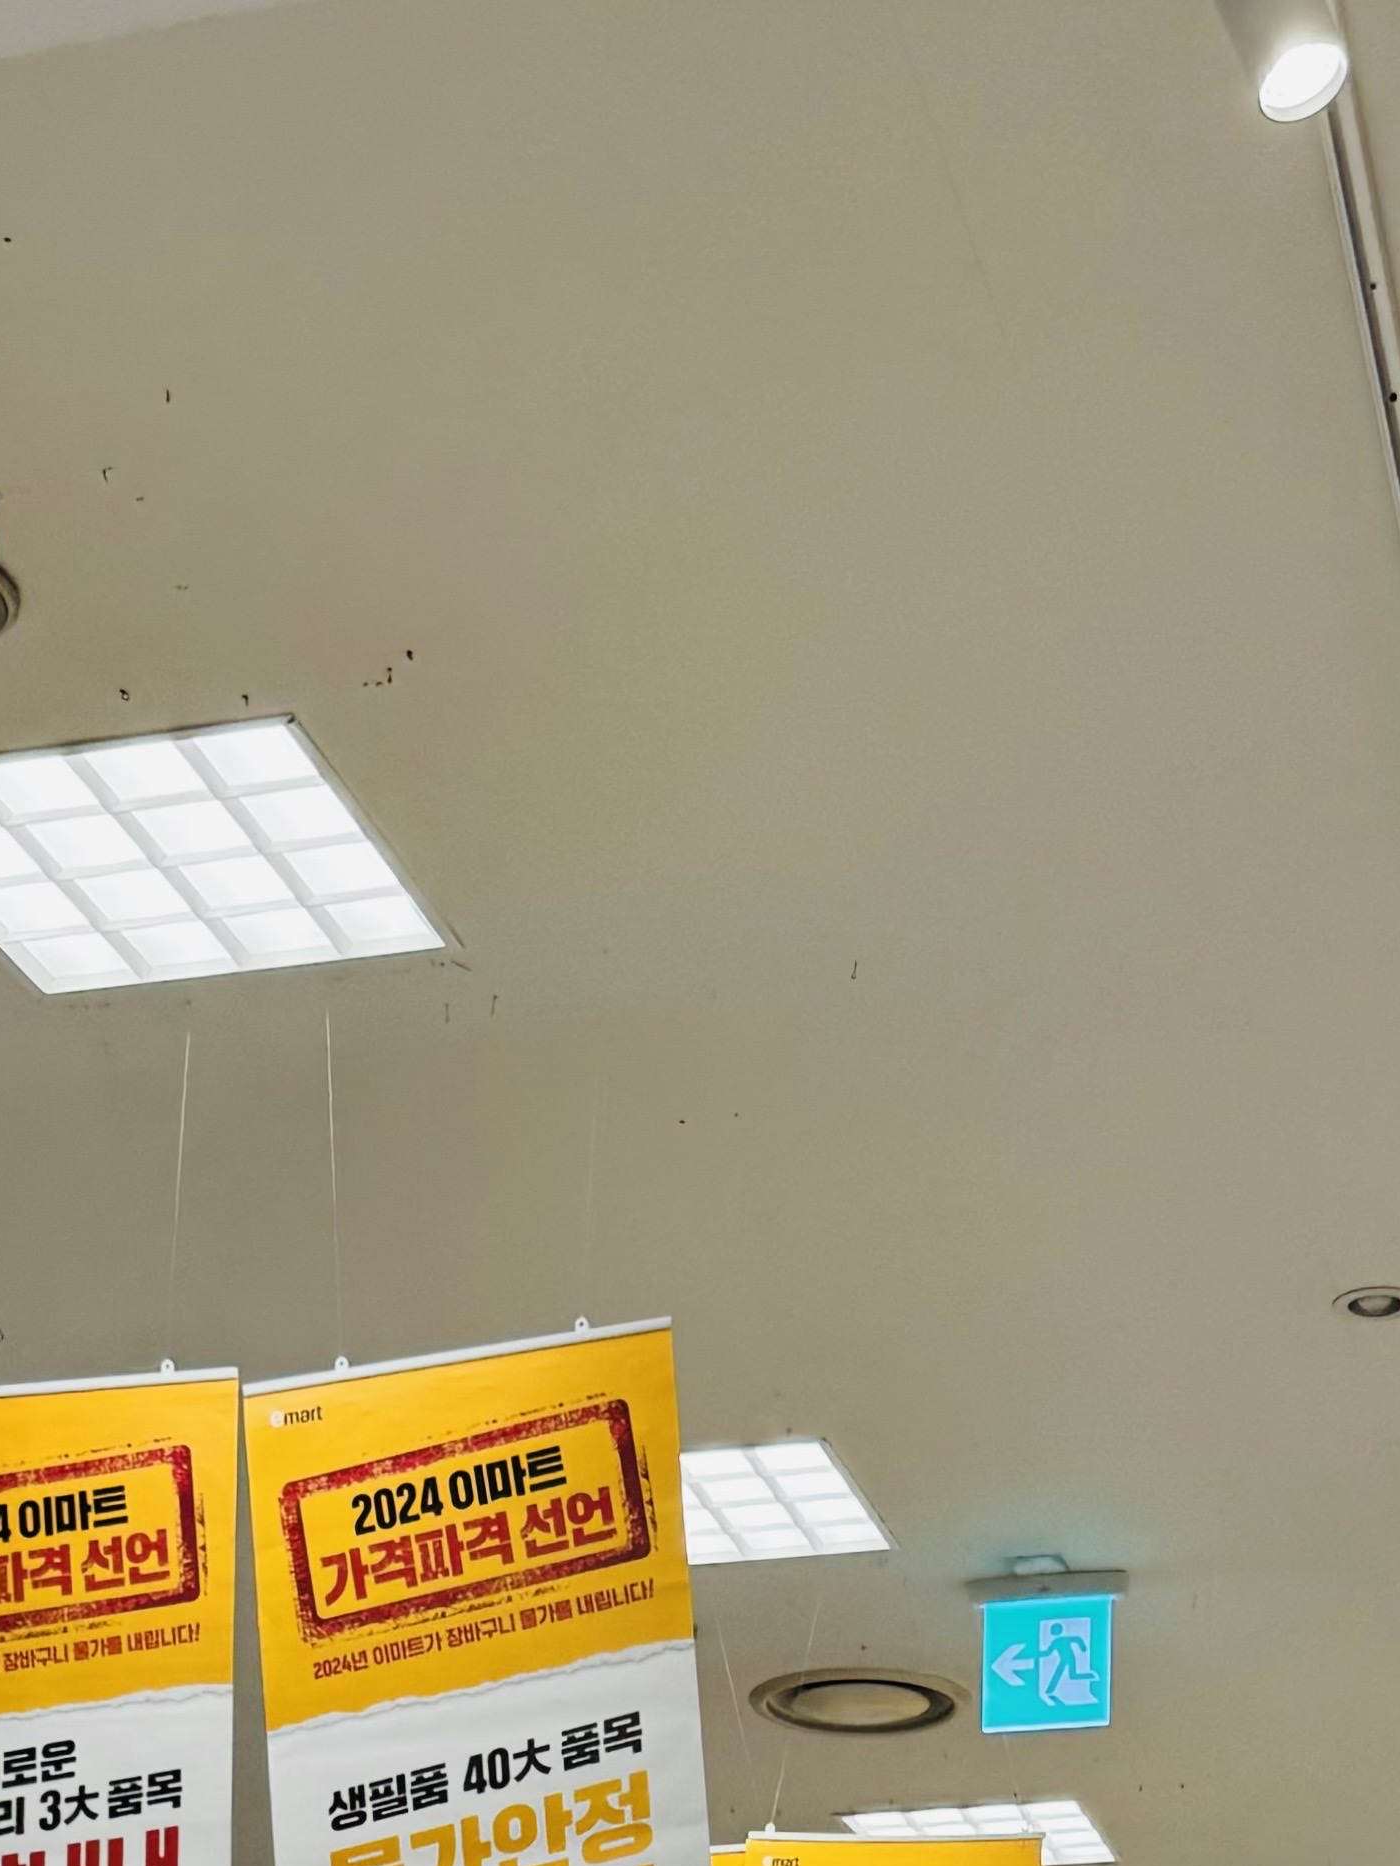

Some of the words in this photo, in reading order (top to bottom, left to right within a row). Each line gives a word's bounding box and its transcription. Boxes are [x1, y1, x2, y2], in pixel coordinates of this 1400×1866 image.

[19, 1485, 128, 1538] 이마트
[352, 1476, 443, 1536] 2024
[449, 1446, 567, 1511] 이마트
[82, 1528, 170, 1592] 선언
[321, 1510, 515, 1607] 가격파격
[521, 1486, 617, 1559] 선언
[3, 1646, 68, 1673] 장바구니
[314, 1654, 369, 1680] 2024년
[374, 1634, 442, 1665] 이마트가
[447, 1619, 516, 1651] 장바구니
[39, 1785, 100, 1831] 3大
[108, 1768, 182, 1819] 품목
[329, 1763, 448, 1831] 생필품
[463, 1738, 551, 1793] 40大
[561, 1711, 642, 1770] 품목
